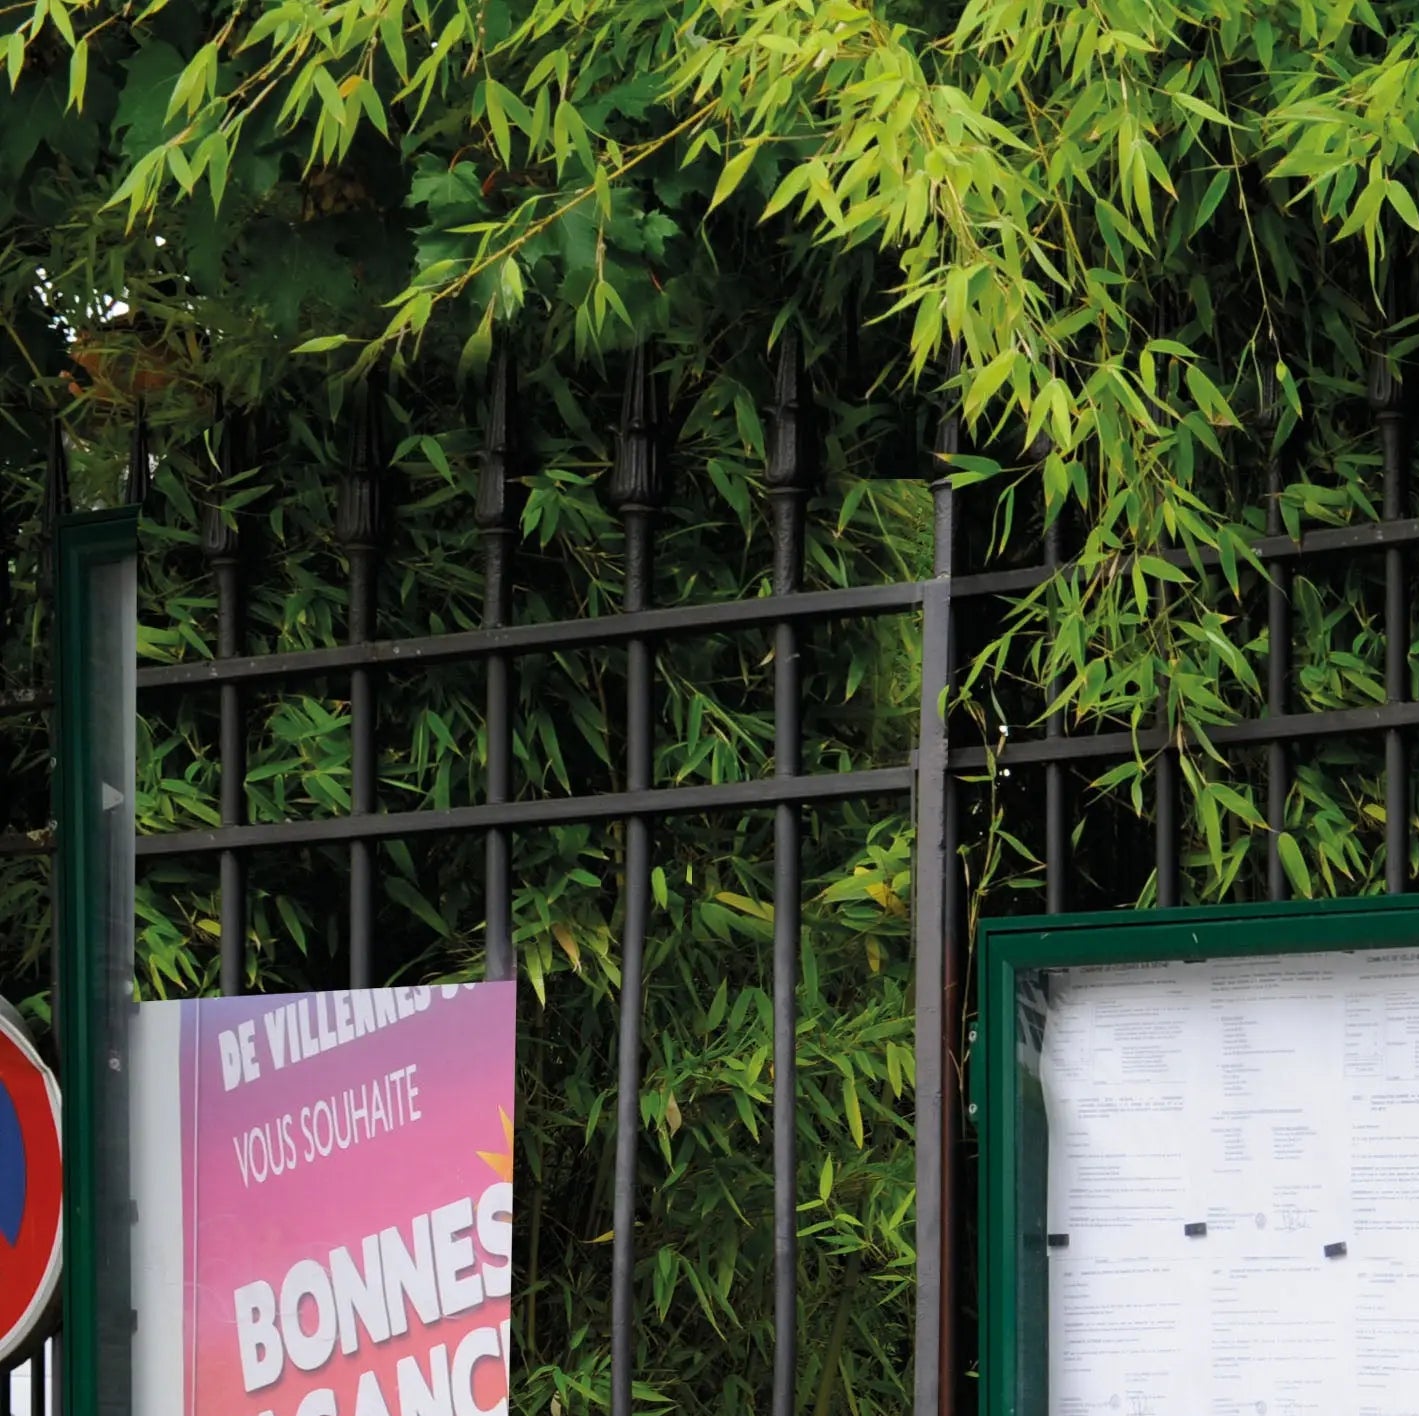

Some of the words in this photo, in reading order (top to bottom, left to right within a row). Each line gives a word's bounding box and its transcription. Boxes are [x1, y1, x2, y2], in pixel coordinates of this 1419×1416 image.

[218, 1020, 261, 1092] DE
[233, 1113, 297, 1188] VOUS
[301, 1064, 422, 1163] SOUHAITE
[234, 1182, 512, 1393] BONNES
